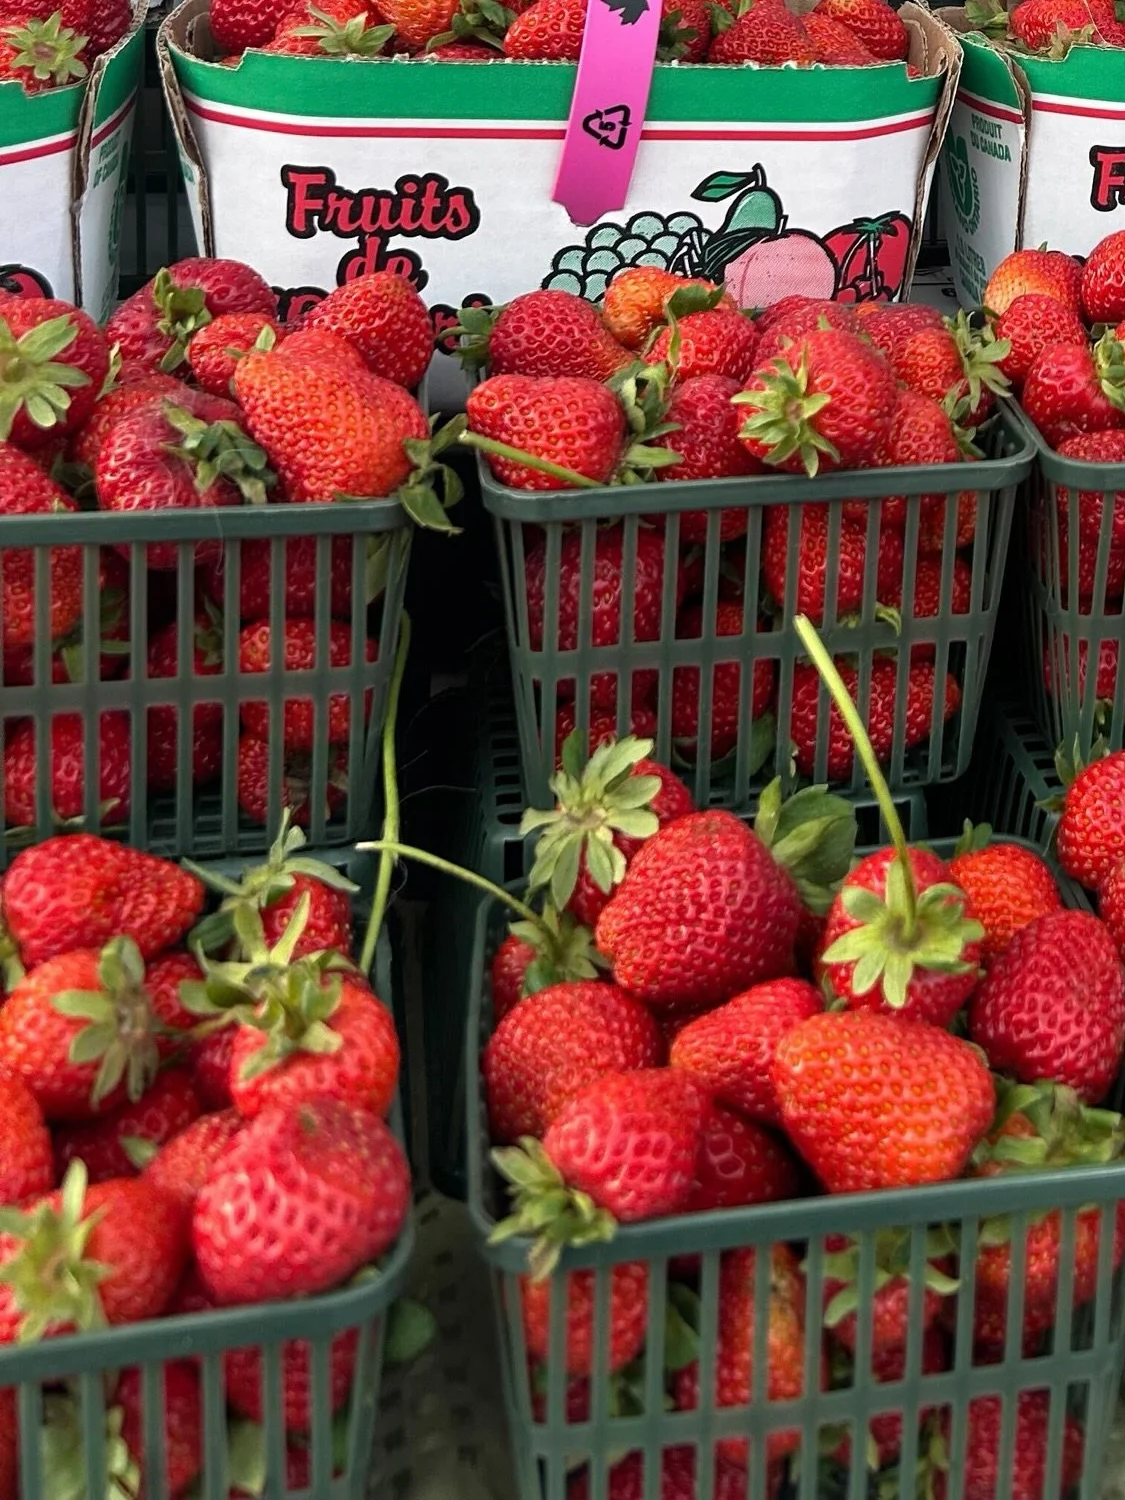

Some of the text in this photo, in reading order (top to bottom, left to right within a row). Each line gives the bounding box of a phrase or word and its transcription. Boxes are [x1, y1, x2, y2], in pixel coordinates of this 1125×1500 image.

[971, 112, 1002, 139] PRODUIT
[979, 137, 1012, 162] CANADA
[281, 164, 480, 240] Fruits
